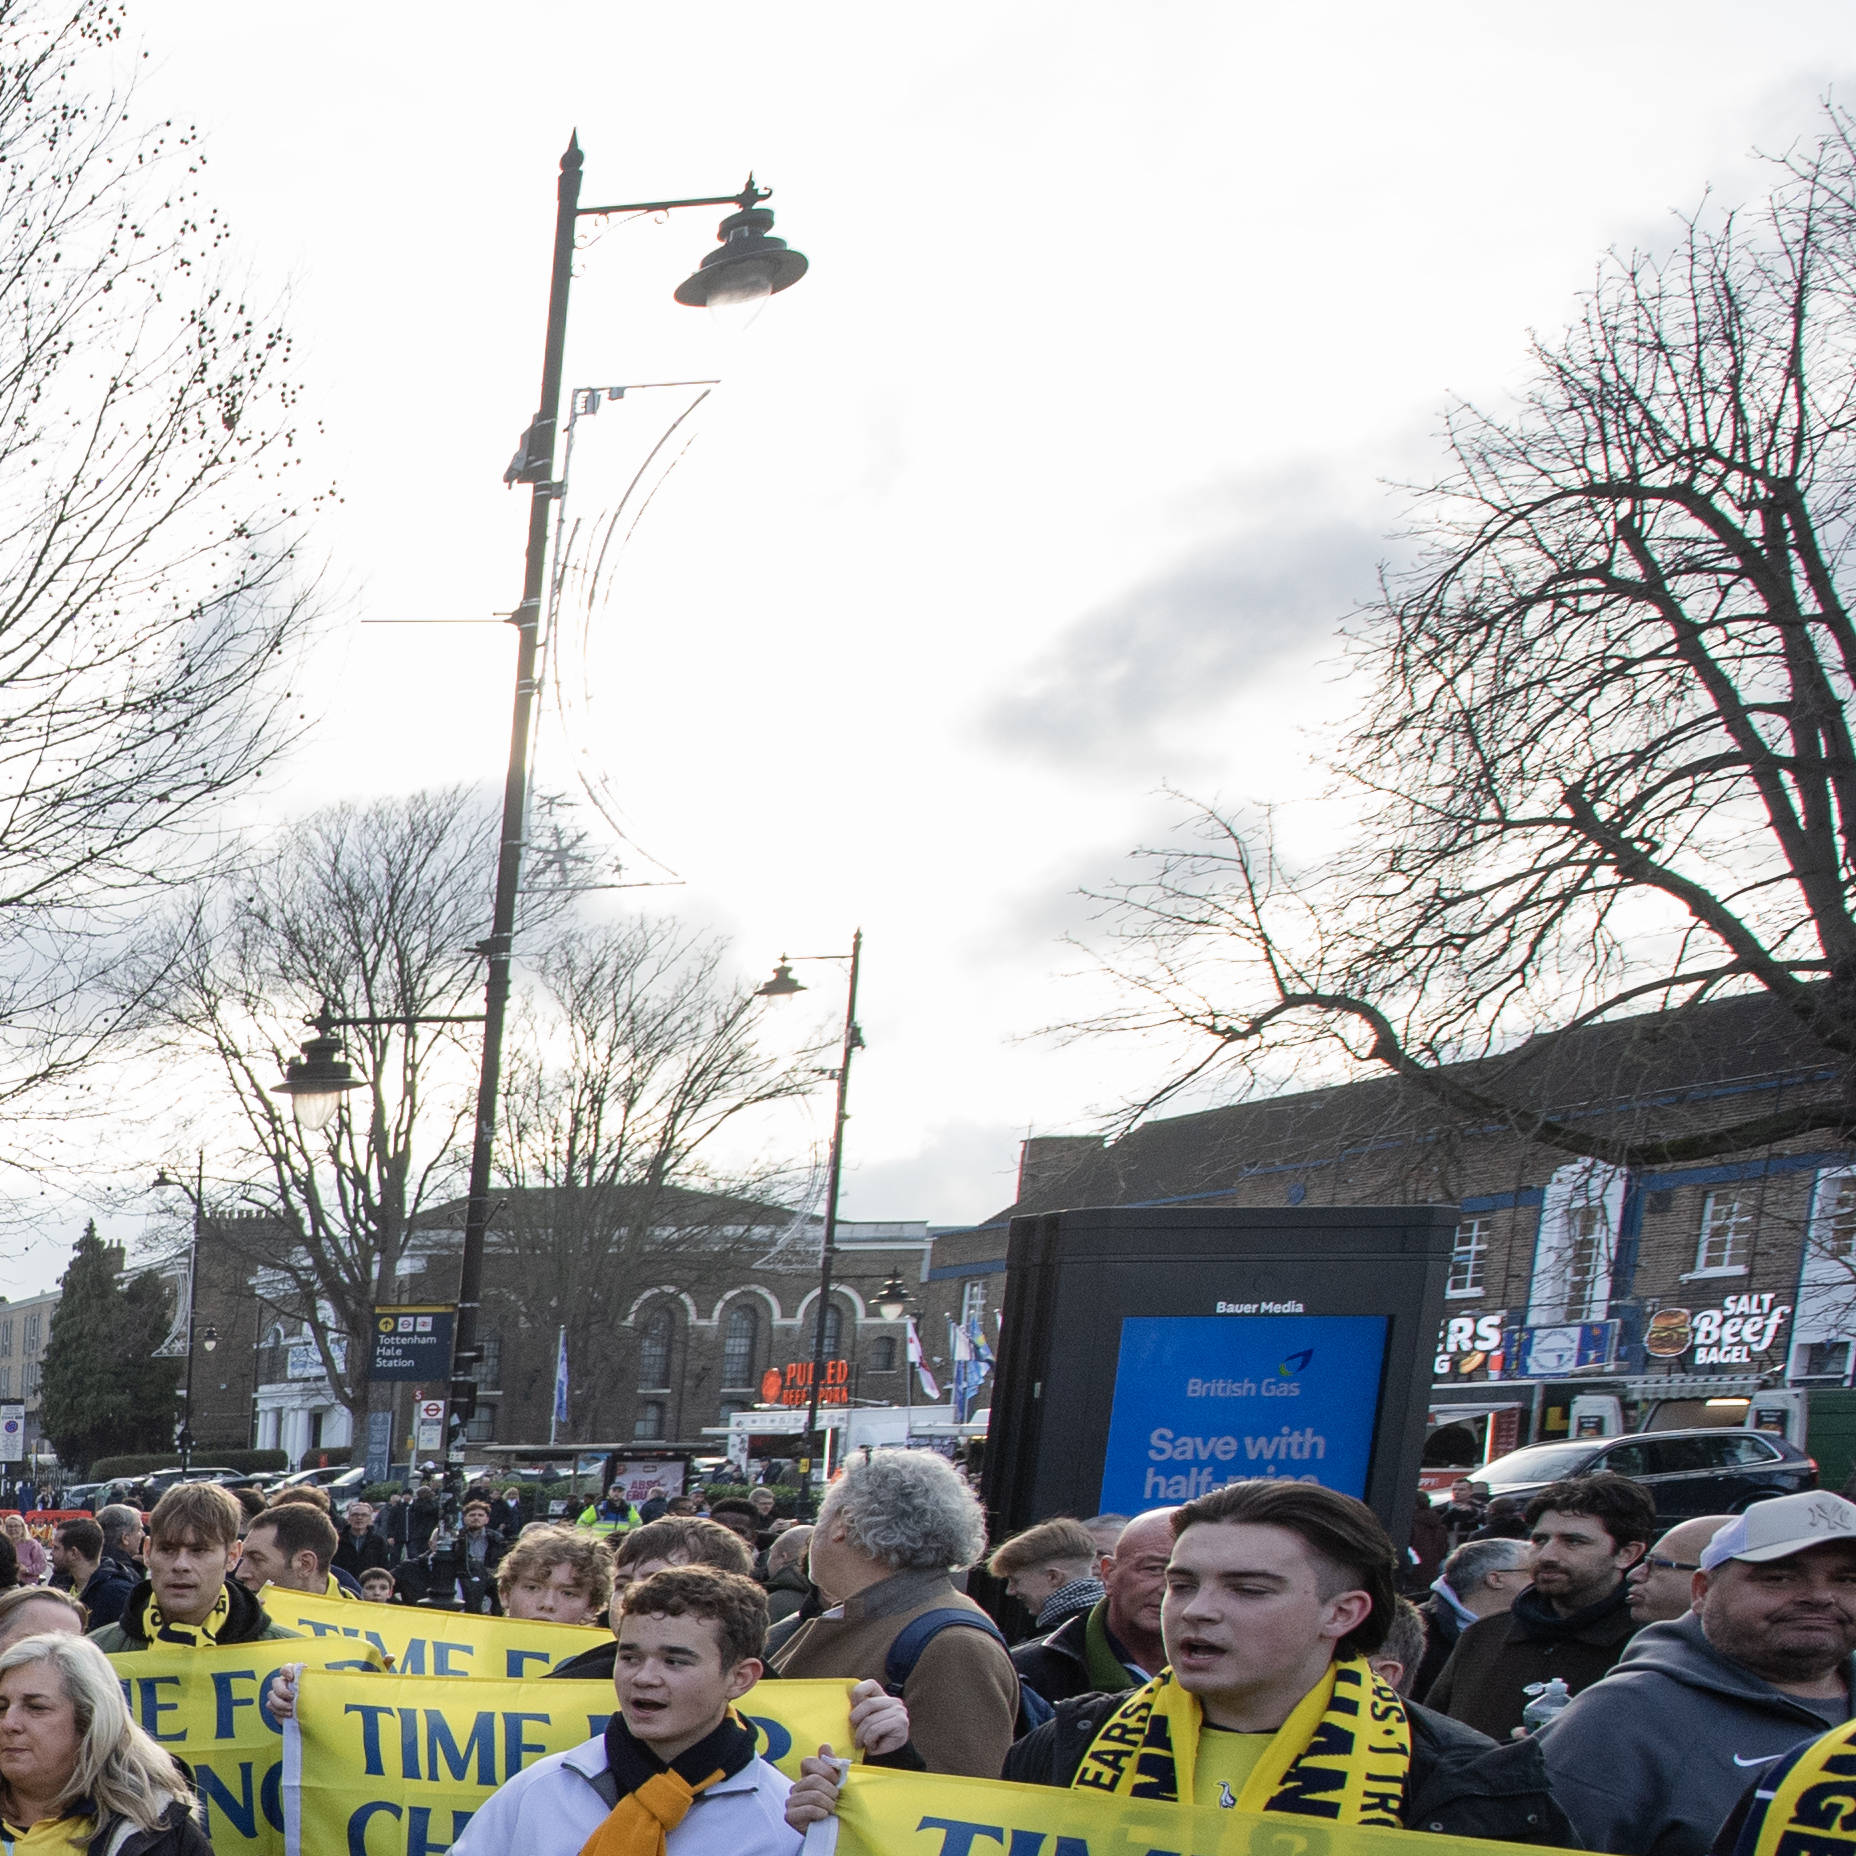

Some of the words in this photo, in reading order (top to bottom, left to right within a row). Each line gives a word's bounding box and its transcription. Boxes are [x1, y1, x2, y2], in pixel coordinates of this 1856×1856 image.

[1216, 1301, 1258, 1313] Bauer
[1260, 1301, 1304, 1313] Media
[1723, 1293, 1776, 1317] SALT
[378, 1334, 437, 1345] Tottenham
[1437, 1315, 1503, 1353] RS
[1692, 1305, 1792, 1351] Beef
[375, 1346, 403, 1356] Hale
[375, 1357, 415, 1367] Station
[1694, 1346, 1751, 1365] BAGEL
[787, 1360, 848, 1386] PULED
[1188, 1378, 1256, 1397] British
[1261, 1378, 1301, 1397] Gas
[1148, 1428, 1238, 1461] Save
[1244, 1426, 1326, 1460] with
[344, 1704, 552, 1787] TIME
[1073, 1699, 1152, 1792] EARS
